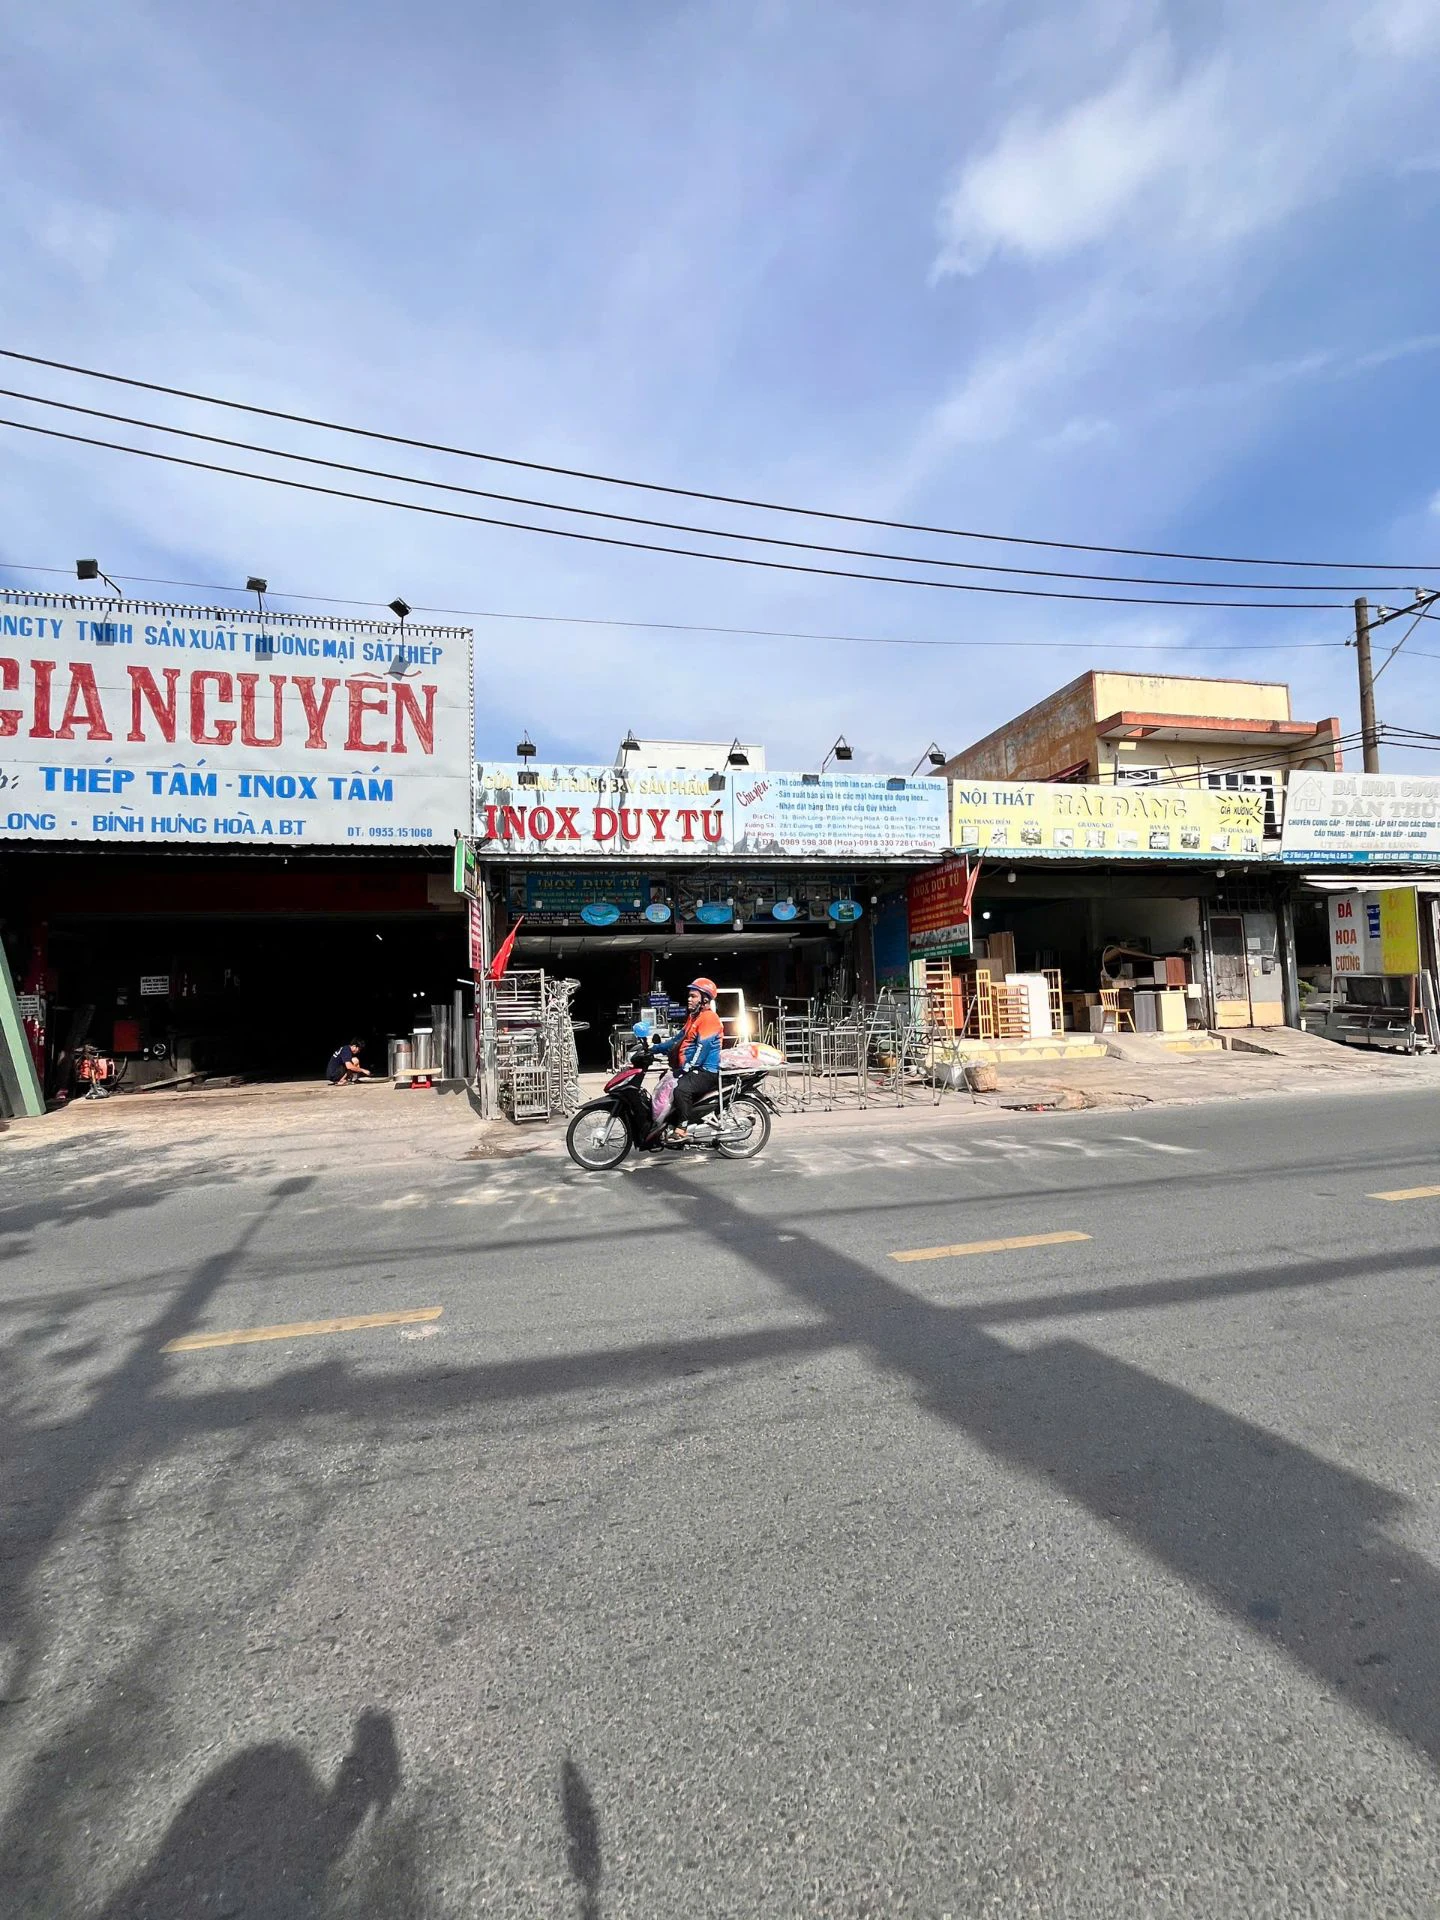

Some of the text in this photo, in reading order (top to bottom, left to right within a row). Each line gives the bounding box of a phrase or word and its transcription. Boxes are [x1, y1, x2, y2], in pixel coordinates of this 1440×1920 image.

[76, 620, 133, 643] TNHH
[127, 665, 438, 754] NGUYỄN
[39, 757, 135, 794] THÉP
[146, 759, 217, 796] TẤM
[238, 775, 317, 799] INOX
[328, 765, 393, 802] TẤM
[960, 787, 987, 807] NỘI
[993, 786, 1035, 806] THẤT
[93, 806, 144, 833] BÌNH
[151, 813, 207, 833] HƯNG
[484, 798, 724, 842] INOX DUY TÚ
[1336, 928, 1357, 945] HOA
